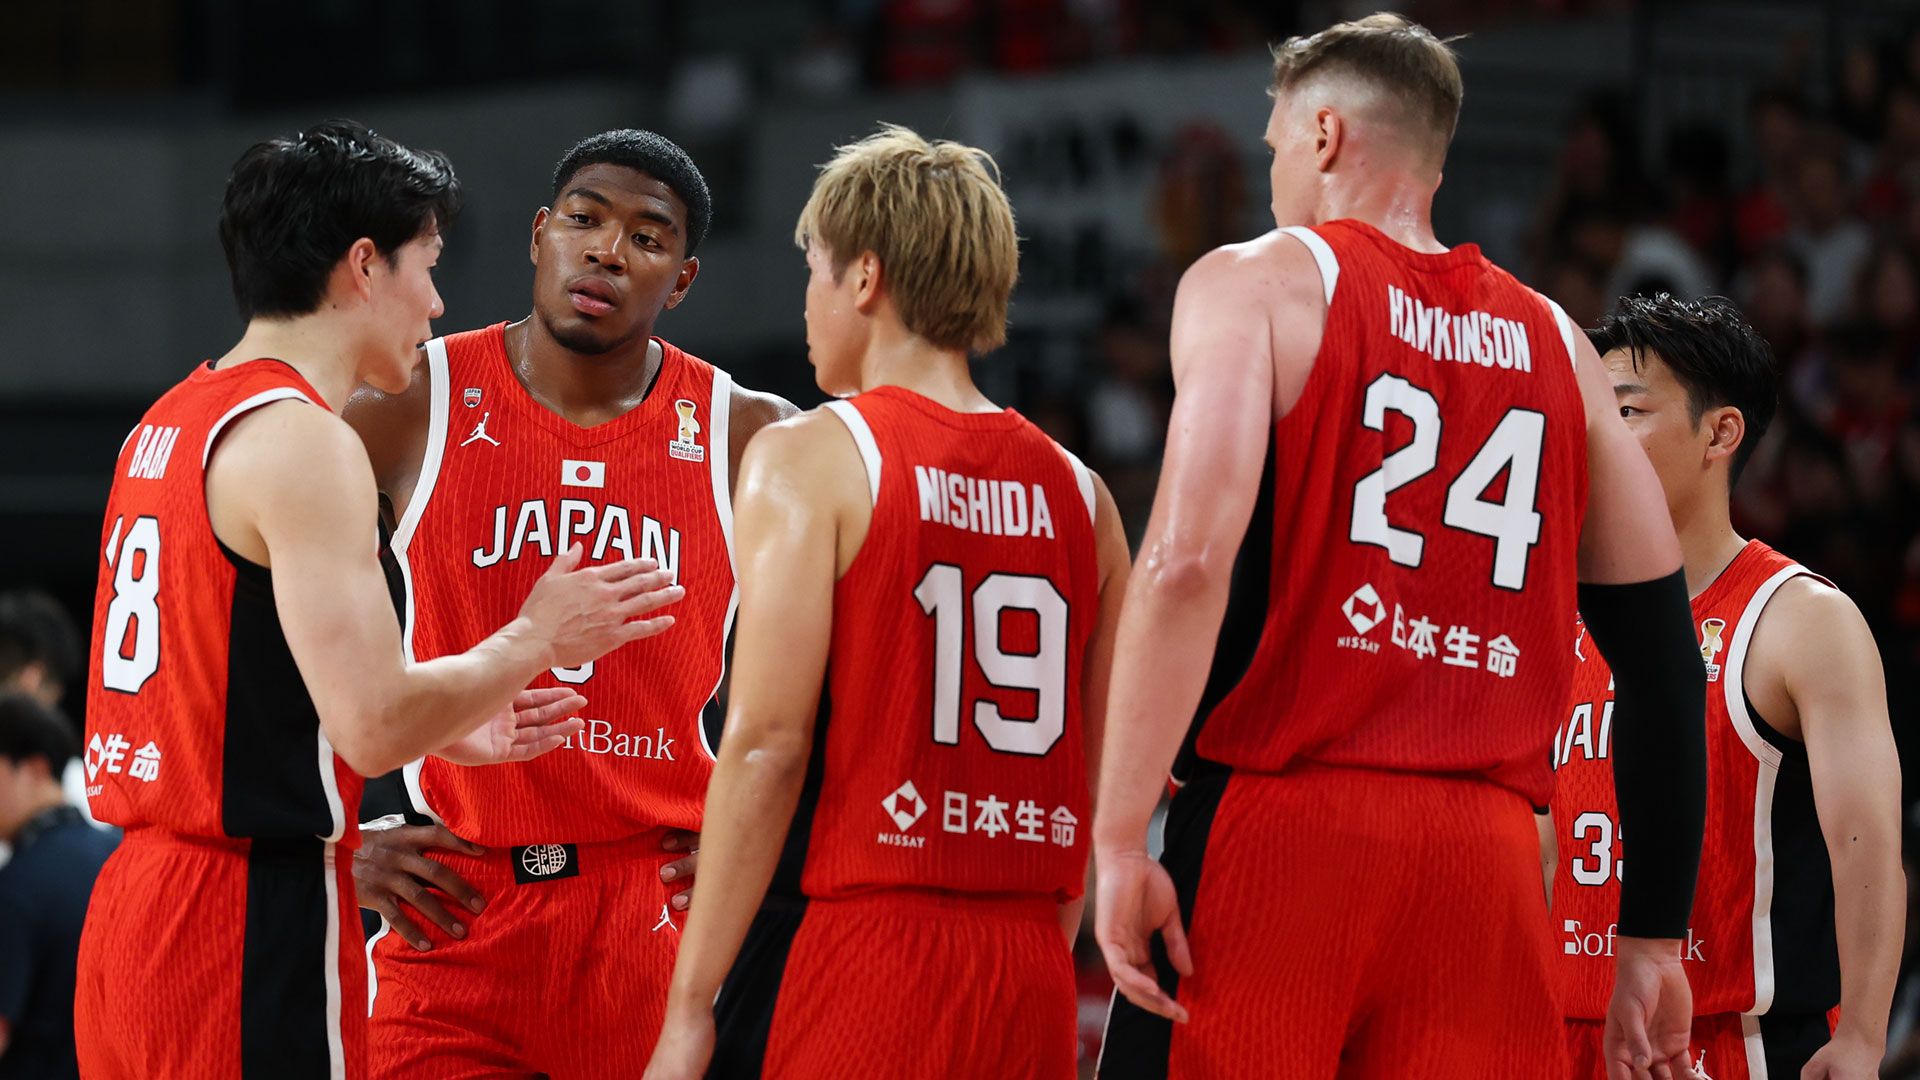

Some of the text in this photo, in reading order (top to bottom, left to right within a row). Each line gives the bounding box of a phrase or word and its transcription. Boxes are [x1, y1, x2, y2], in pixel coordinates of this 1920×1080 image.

[1387, 283, 1532, 373] HAWKINSON
[671, 450, 702, 460] QUALIFIERS
[1350, 371, 1546, 592] 24
[915, 465, 1055, 539] NISHIDA
[471, 498, 680, 587] JAPAN
[913, 560, 1069, 757] 19
[1337, 636, 1380, 654] NISSAY
[563, 717, 675, 761] tBank
[877, 832, 925, 848] NISSAY
[943, 790, 1078, 848] 日本生命
[1572, 811, 1624, 887] 3
